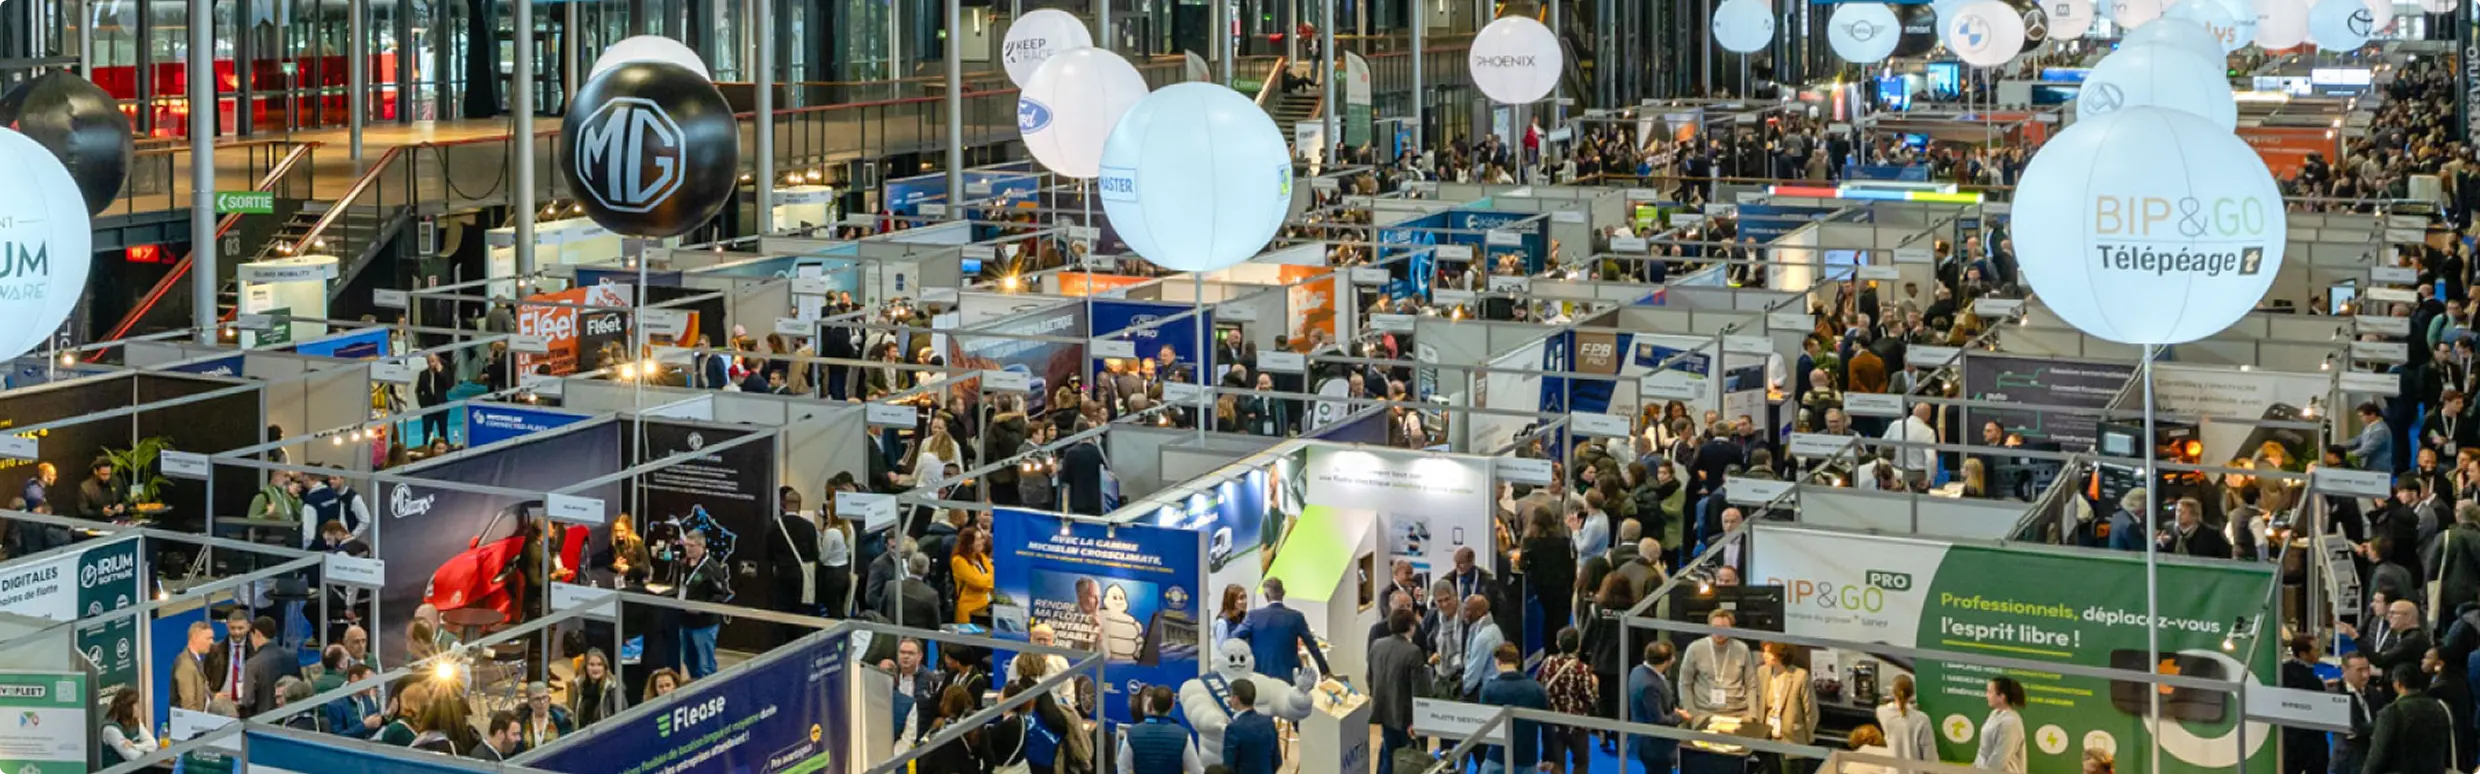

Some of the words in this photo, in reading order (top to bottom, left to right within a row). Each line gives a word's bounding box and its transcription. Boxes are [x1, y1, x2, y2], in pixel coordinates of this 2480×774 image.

[1017, 38, 1047, 50] KEEP
[584, 106, 676, 205] MG
[227, 191, 274, 210] SORTIE
[224, 237, 241, 257] 03
[2097, 244, 2237, 277] Télépéage
[1028, 541, 1079, 556] MICHELIN
[1080, 537, 1095, 547] LA
[98, 551, 134, 575] IRIUM
[2, 566, 59, 593] DIGITALES
[1870, 572, 1909, 589] PRO
[1034, 608, 1052, 618] MA
[1940, 591, 2080, 622] Professionnels,
[1940, 616, 2016, 642] l'esprit
[2019, 624, 2070, 648] libre
[2074, 628, 2082, 648] !
[673, 694, 727, 733] Flease
